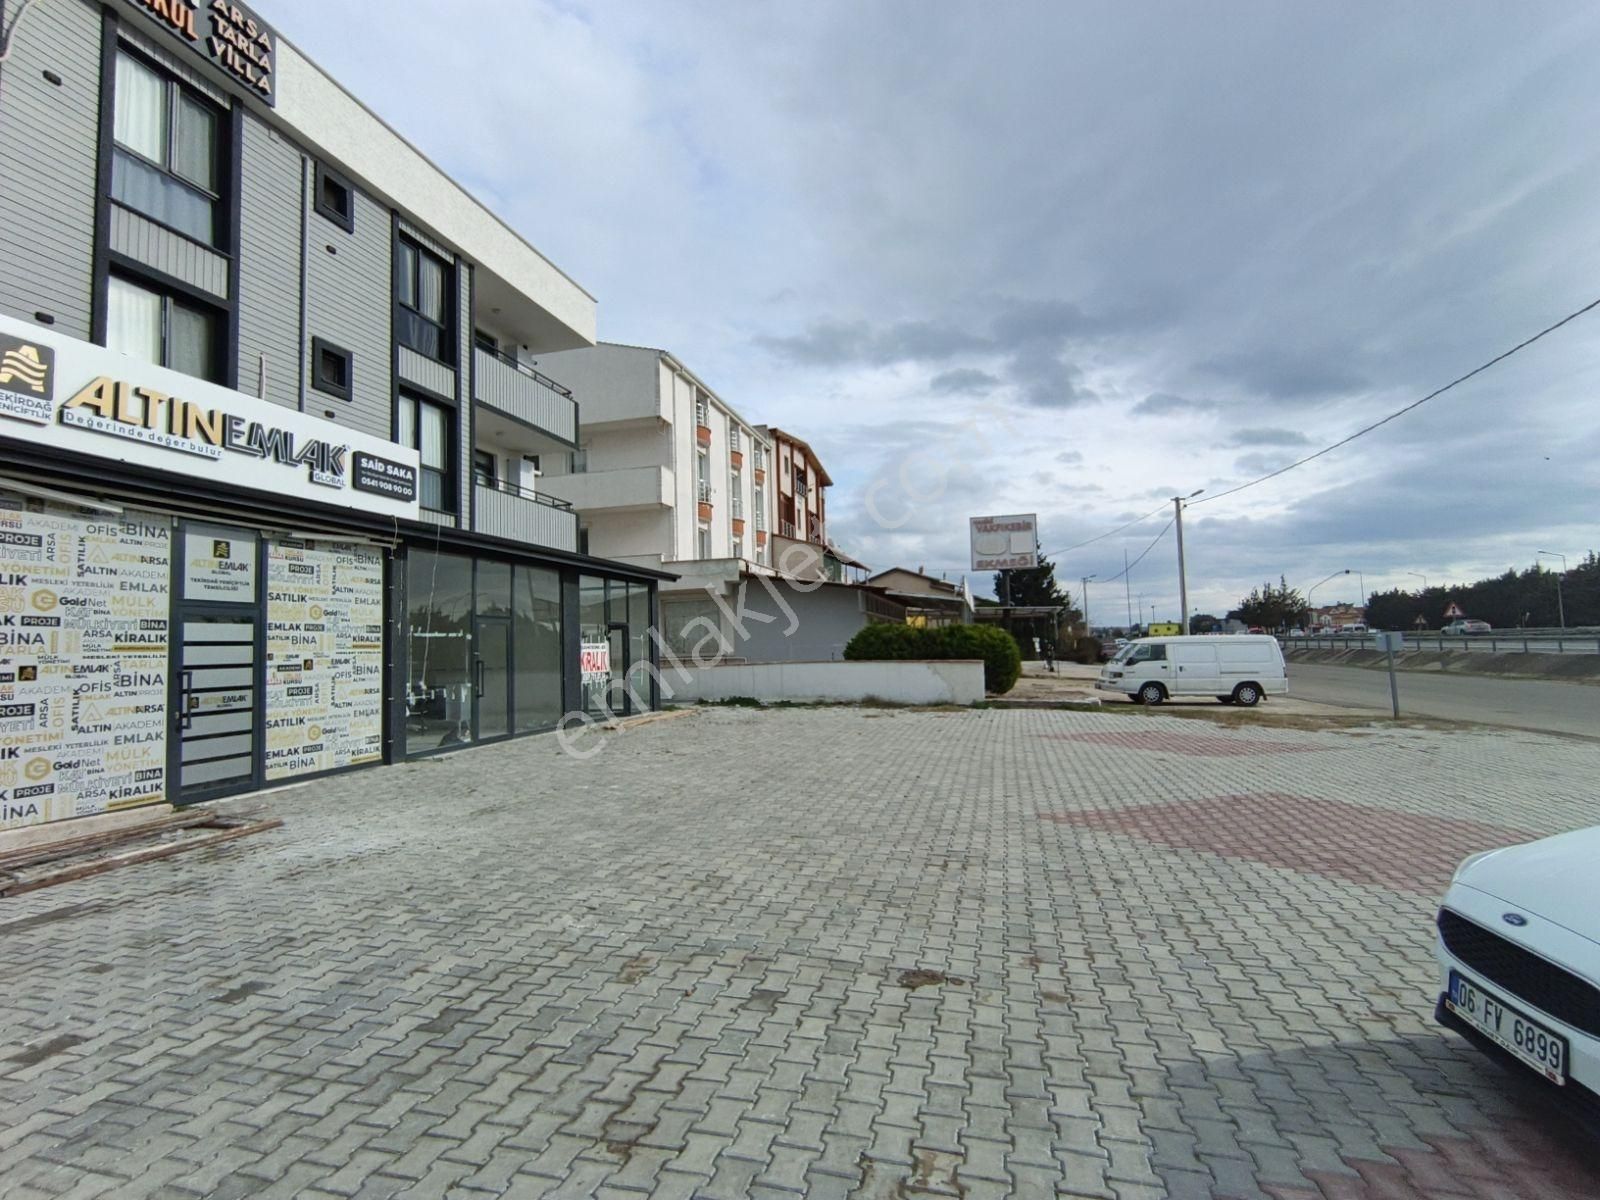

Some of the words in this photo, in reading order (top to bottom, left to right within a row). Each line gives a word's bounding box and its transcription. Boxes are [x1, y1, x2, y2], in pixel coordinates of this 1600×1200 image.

[209, 0, 272, 52] ARSA
[209, 15, 272, 73] TARLA
[65, 410, 144, 439] Değerinde
[148, 431, 186, 448] değer
[361, 458, 385, 472] SAİD
[386, 465, 413, 480] SAKA
[313, 471, 347, 487] GLOBAL
[86, 524, 118, 537] OFİS
[126, 521, 169, 540] BİNA
[46, 533, 55, 561] ARSA
[120, 538, 143, 546] ALTIN
[77, 536, 86, 577] SATILIK
[357, 553, 381, 565] BİNA
[84, 565, 118, 576] ALTIN
[119, 581, 168, 593] EMLAK
[268, 592, 307, 603] SATILIK
[141, 620, 166, 630] BİNA
[268, 622, 302, 631] EMLAK
[83, 630, 113, 638] ARSA
[114, 631, 168, 643] KİRALIK
[291, 633, 317, 645] BİNA
[356, 663, 379, 675] BİNA
[121, 671, 164, 687] BİNA
[80, 680, 112, 693] OFİS
[40, 697, 48, 728] ARSA
[71, 687, 80, 731] SATILIK
[78, 723, 112, 735] ALTIN
[266, 716, 306, 729] SATILIK
[114, 731, 164, 745] EMLAK
[266, 747, 300, 760] EMLAK
[290, 757, 316, 769] BİNA
[16, 785, 52, 798] PROJE
[77, 789, 107, 800] ARSA
[109, 782, 163, 800] KİRALIK
[1458, 983, 1476, 1013] 06
[1483, 998, 1503, 1032] FV
[1513, 1018, 1560, 1069] 6899
